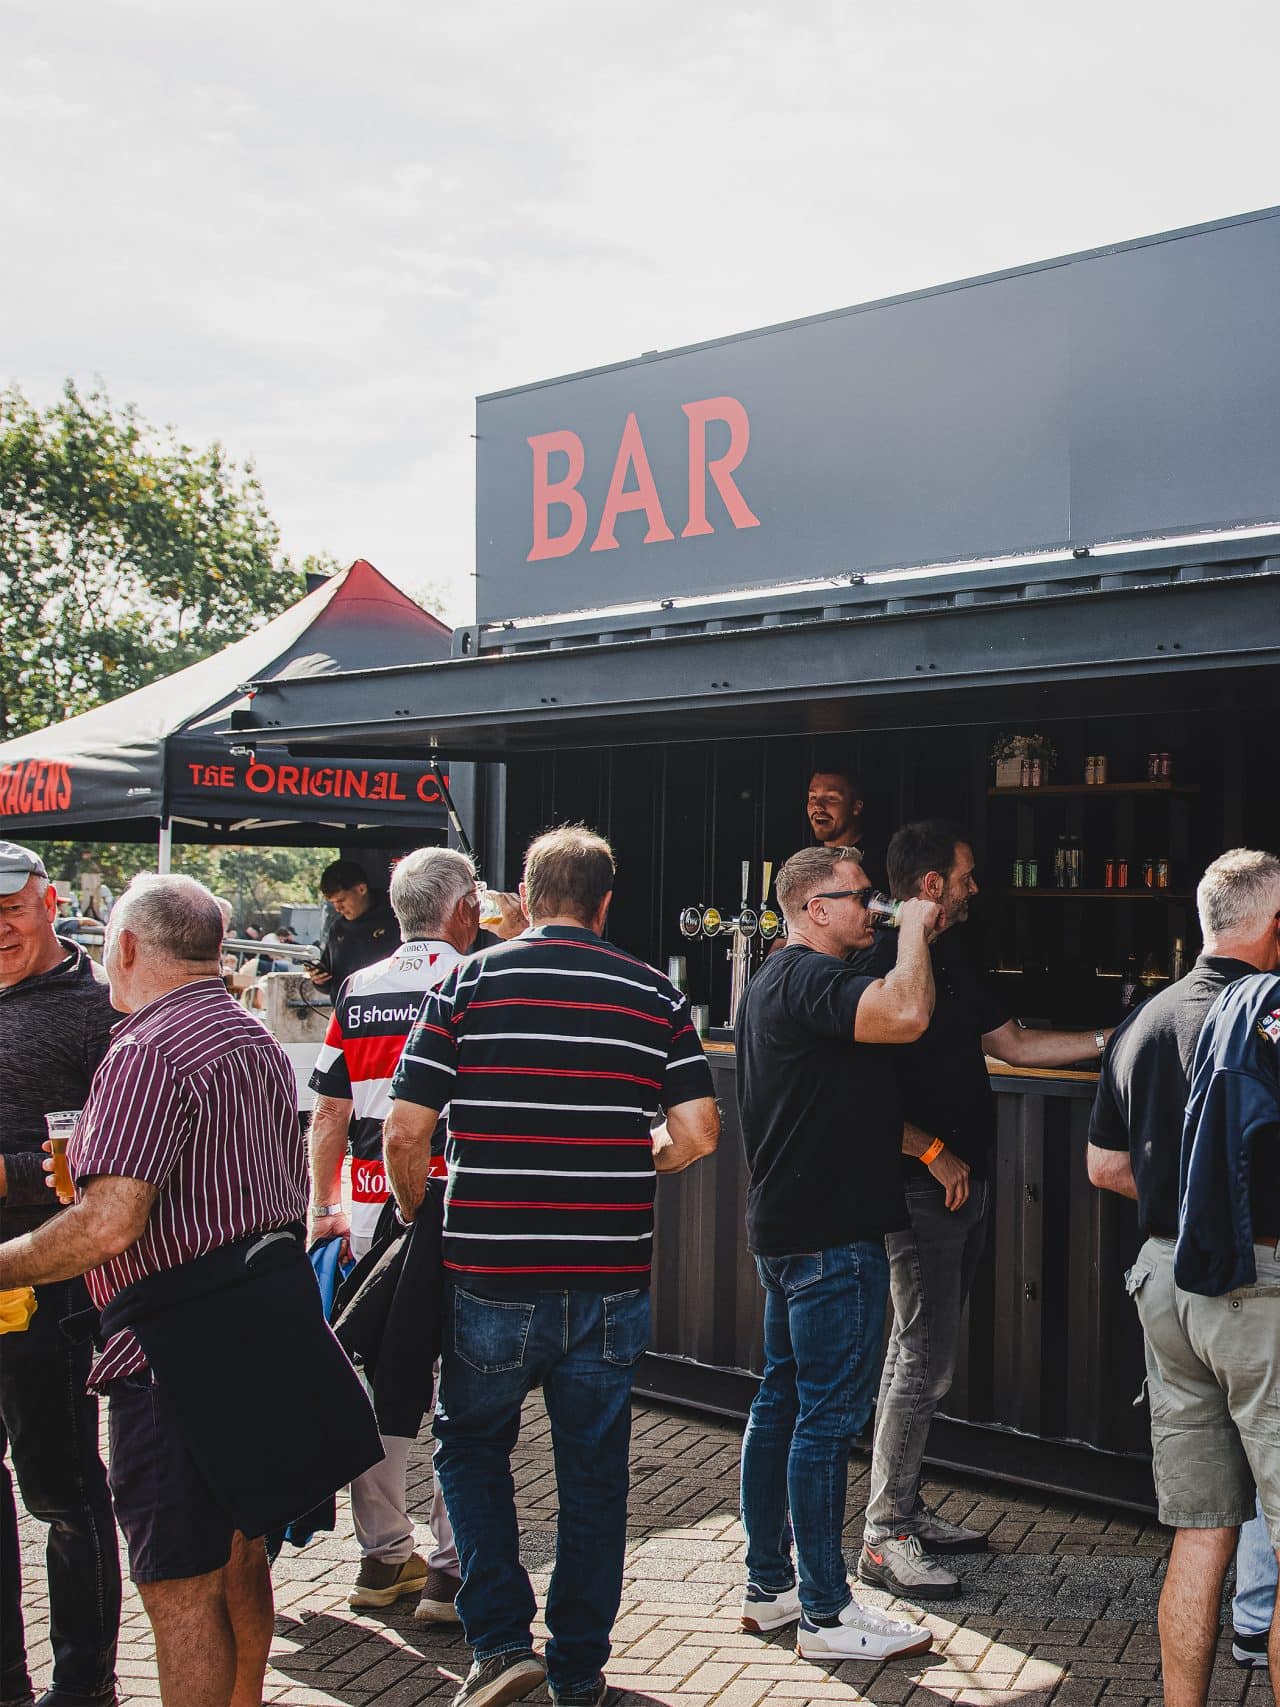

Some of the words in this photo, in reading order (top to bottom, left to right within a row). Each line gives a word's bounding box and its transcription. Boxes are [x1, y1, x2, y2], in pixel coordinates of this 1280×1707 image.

[526, 395, 761, 562] BAR
[188, 764, 235, 788] THE
[245, 763, 406, 800] ORIGINAL
[416, 774, 449, 803] C
